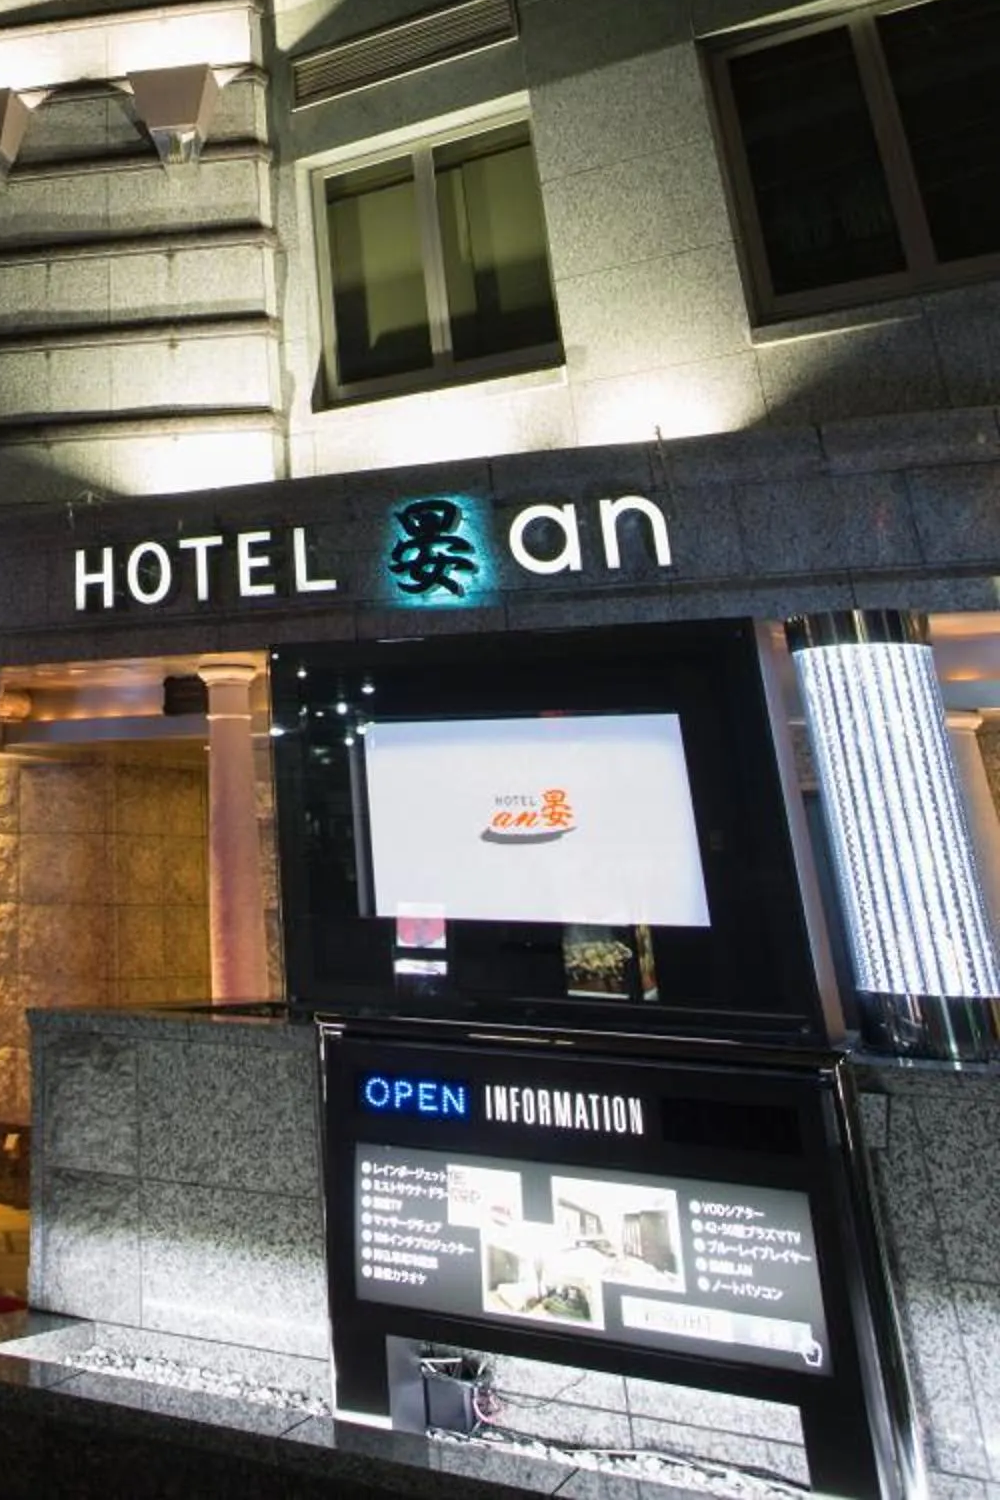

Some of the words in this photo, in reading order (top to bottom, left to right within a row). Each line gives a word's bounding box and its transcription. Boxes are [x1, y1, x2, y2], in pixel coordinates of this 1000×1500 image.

[74, 526, 337, 611] HOTEL
[508, 494, 672, 575] an
[495, 795, 537, 807] HOTEL
[364, 1076, 466, 1115] OPEN
[485, 1084, 644, 1136] INFORMATION
